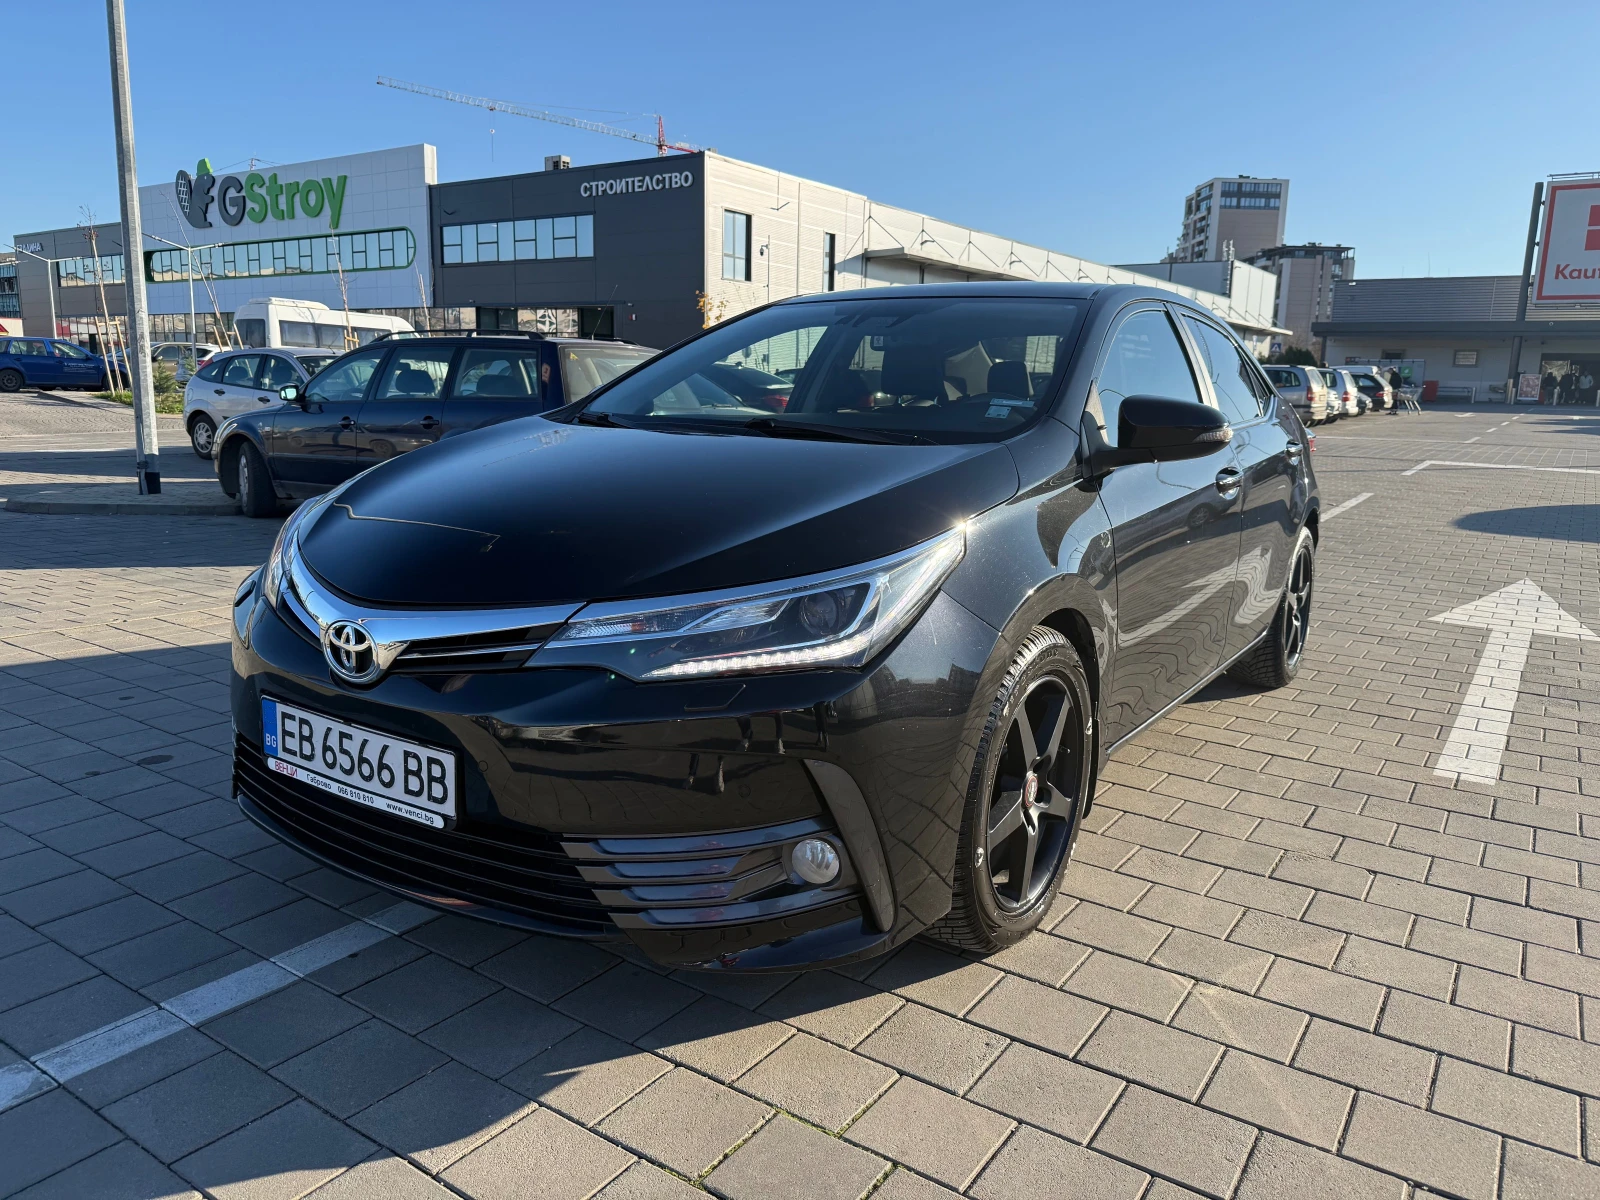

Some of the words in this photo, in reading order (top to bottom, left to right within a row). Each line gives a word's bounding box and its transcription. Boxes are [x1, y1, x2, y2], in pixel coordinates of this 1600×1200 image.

[218, 172, 347, 229] GStroy
[580, 171, 694, 198] СТРОИТЕЛСТВО
[266, 733, 277, 748] BG
[280, 711, 316, 761] EB
[322, 726, 395, 789] 6566
[404, 750, 448, 804] BB
[274, 760, 298, 778] ВЕНЦИ
[307, 773, 332, 790] Габрово
[386, 801, 434, 824] www.venci.bg
